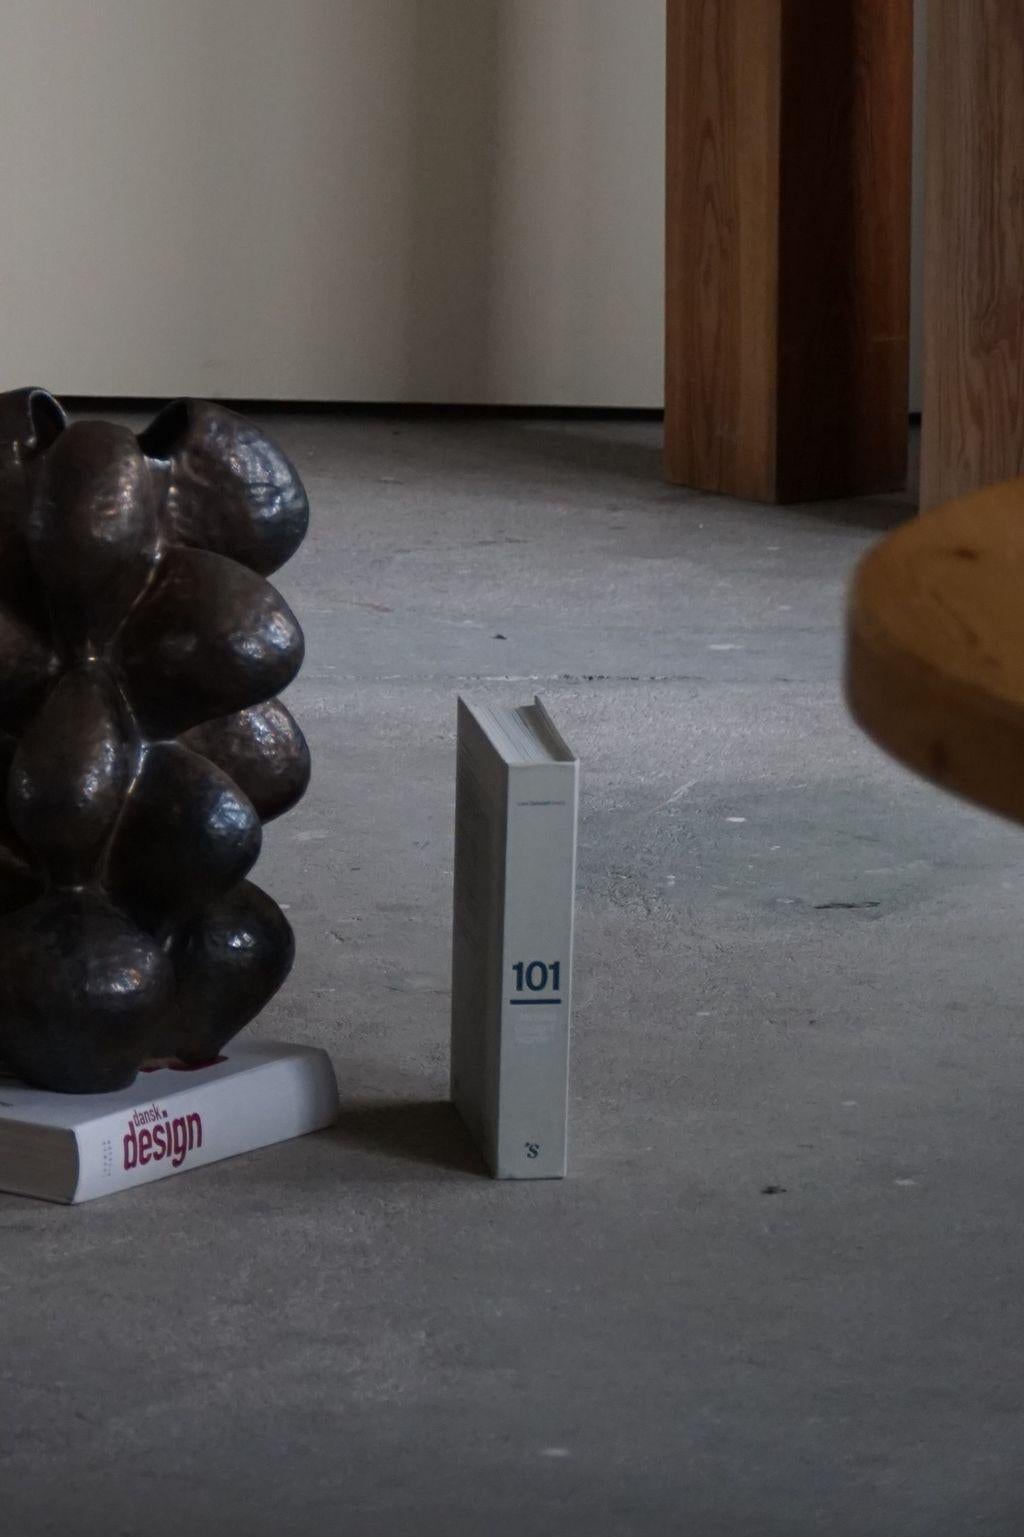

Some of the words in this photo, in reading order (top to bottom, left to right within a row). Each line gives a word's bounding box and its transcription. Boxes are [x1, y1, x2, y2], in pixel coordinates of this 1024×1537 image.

[512, 961, 560, 991] 101
[133, 1104, 162, 1126] dansk
[123, 1110, 202, 1170] design
